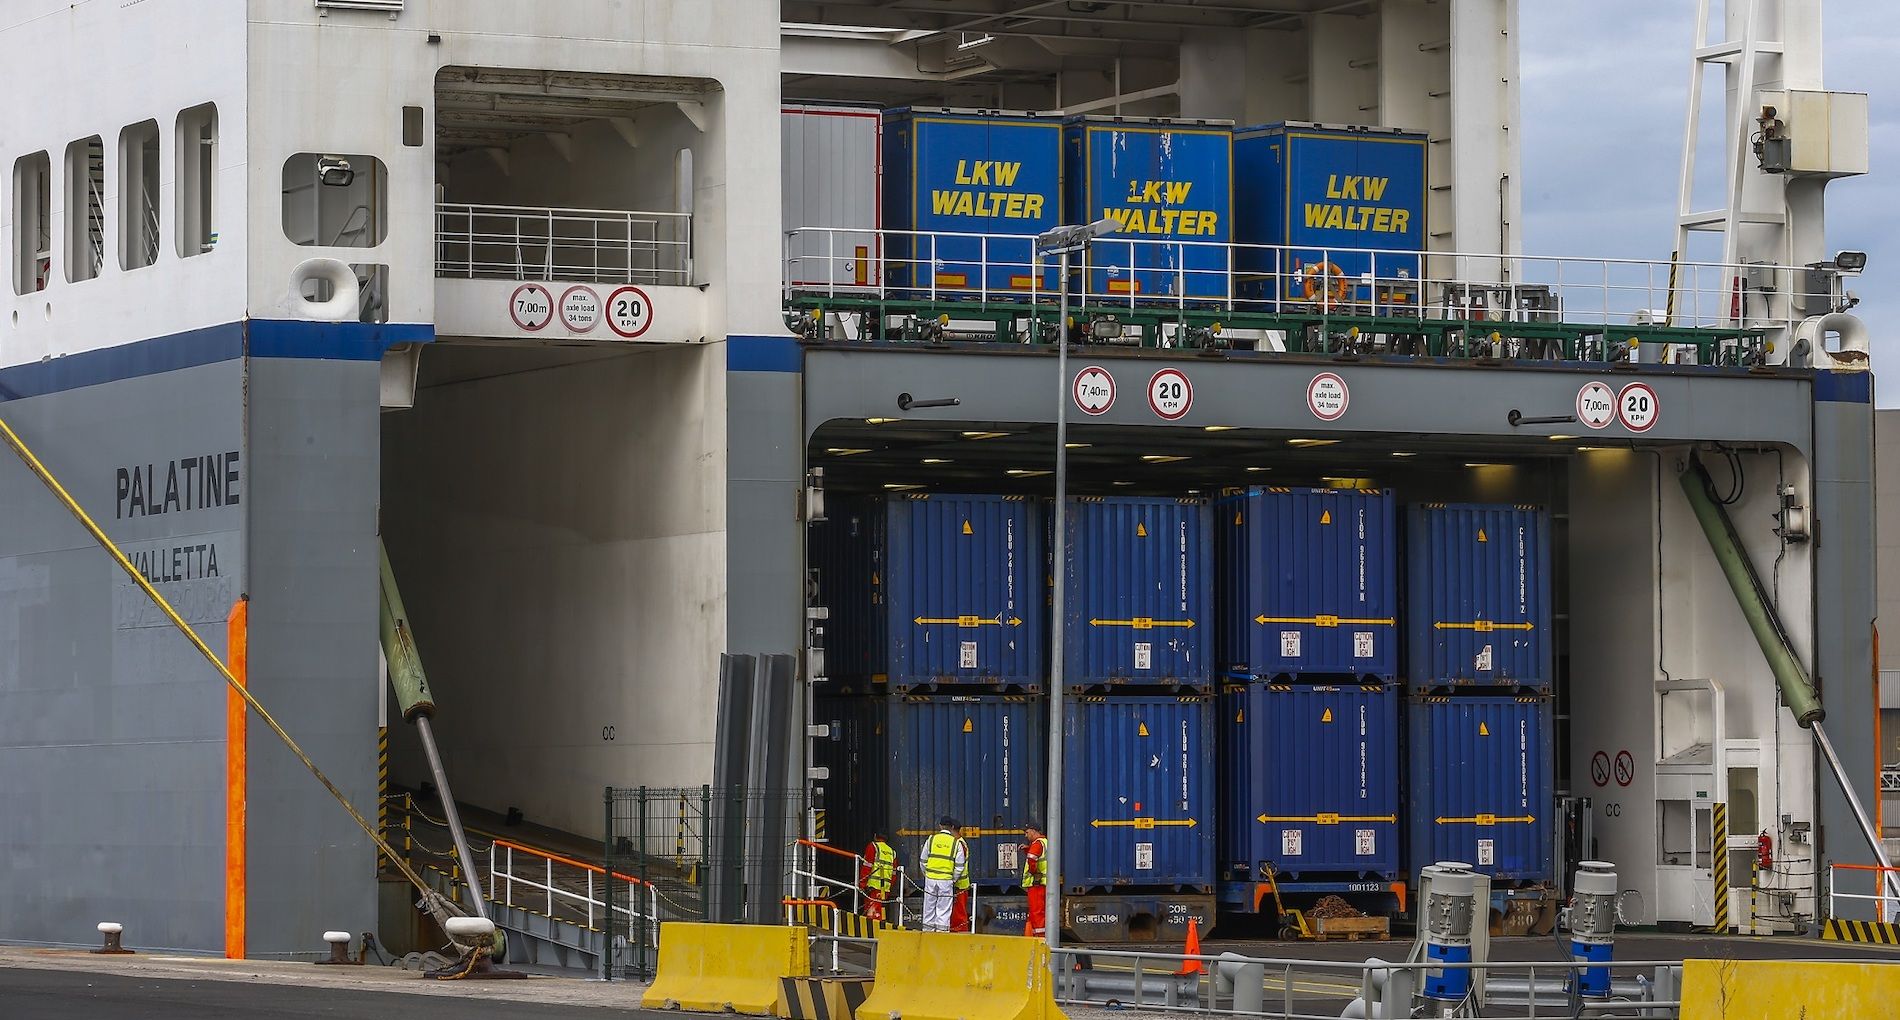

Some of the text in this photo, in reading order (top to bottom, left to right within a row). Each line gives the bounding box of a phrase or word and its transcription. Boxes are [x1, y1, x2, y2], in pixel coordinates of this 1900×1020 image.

[955, 159, 1021, 186] LKW
[1327, 174, 1389, 201] LKW
[932, 190, 1045, 219] WALTER
[1103, 207, 1218, 236] WALTER
[1304, 203, 1410, 233] WALTER
[518, 300, 547, 314] 7,00m
[617, 300, 641, 317] 20
[569, 314, 592, 322] 34 tons
[1081, 384, 1108, 397] 7,40m
[1159, 382, 1181, 399] 20
[1317, 401, 1339, 409] 34 tons
[1584, 399, 1610, 412] 7,00m
[1628, 396, 1648, 412] 20
[116, 451, 240, 519] PALATINE
[128, 543, 219, 584] VALLETTA
[602, 726, 615, 740] CC
[1605, 803, 1621, 817] CC
[1349, 884, 1379, 892] 1001123
